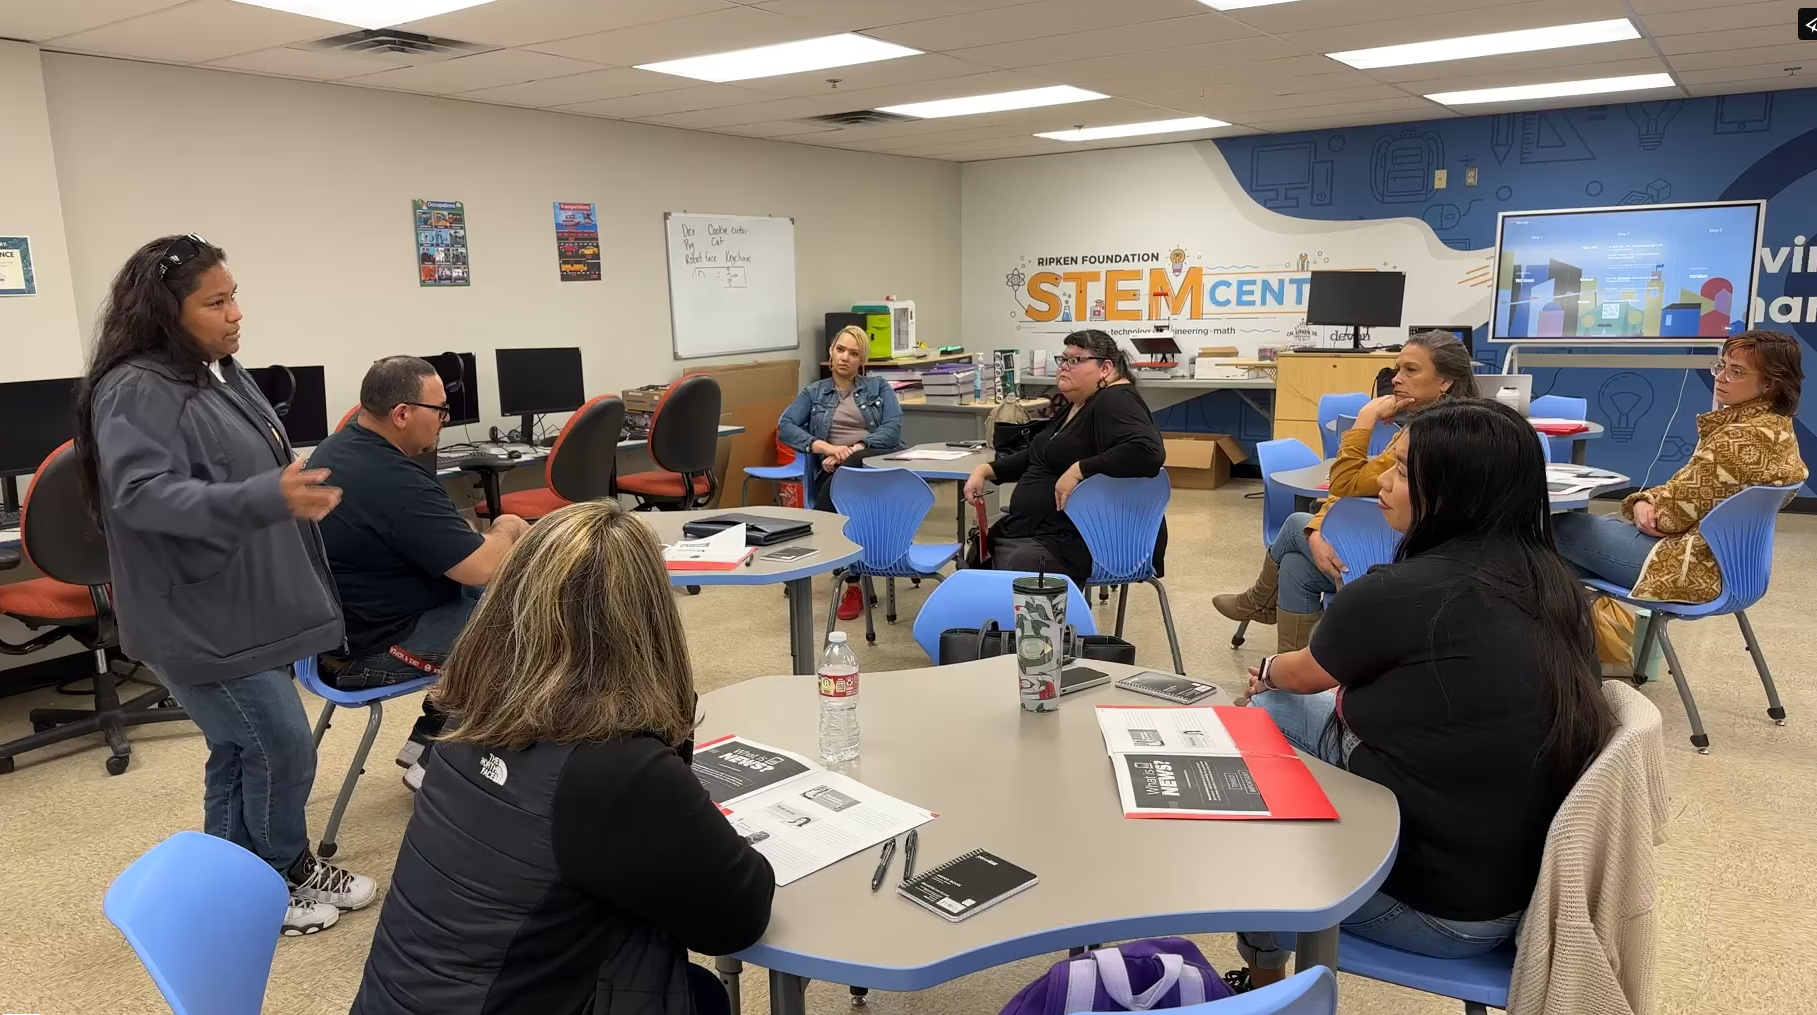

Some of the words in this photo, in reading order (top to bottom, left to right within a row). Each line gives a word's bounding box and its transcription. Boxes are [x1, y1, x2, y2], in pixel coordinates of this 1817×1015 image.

[427, 201, 456, 209] Occupations
[710, 236, 726, 247] Cat
[1037, 255, 1078, 267] RIPKEN
[1081, 252, 1160, 266] FOUNDATION
[1026, 266, 1204, 322] STEM
[1208, 277, 1311, 308] CENT
[1213, 326, 1236, 335] math
[718, 751, 775, 773] NEWS?
[480, 766, 497, 781] FACE
[1142, 768, 1156, 776] is
[1153, 759, 1181, 797] NEWS?
[1144, 775, 1159, 796] What
